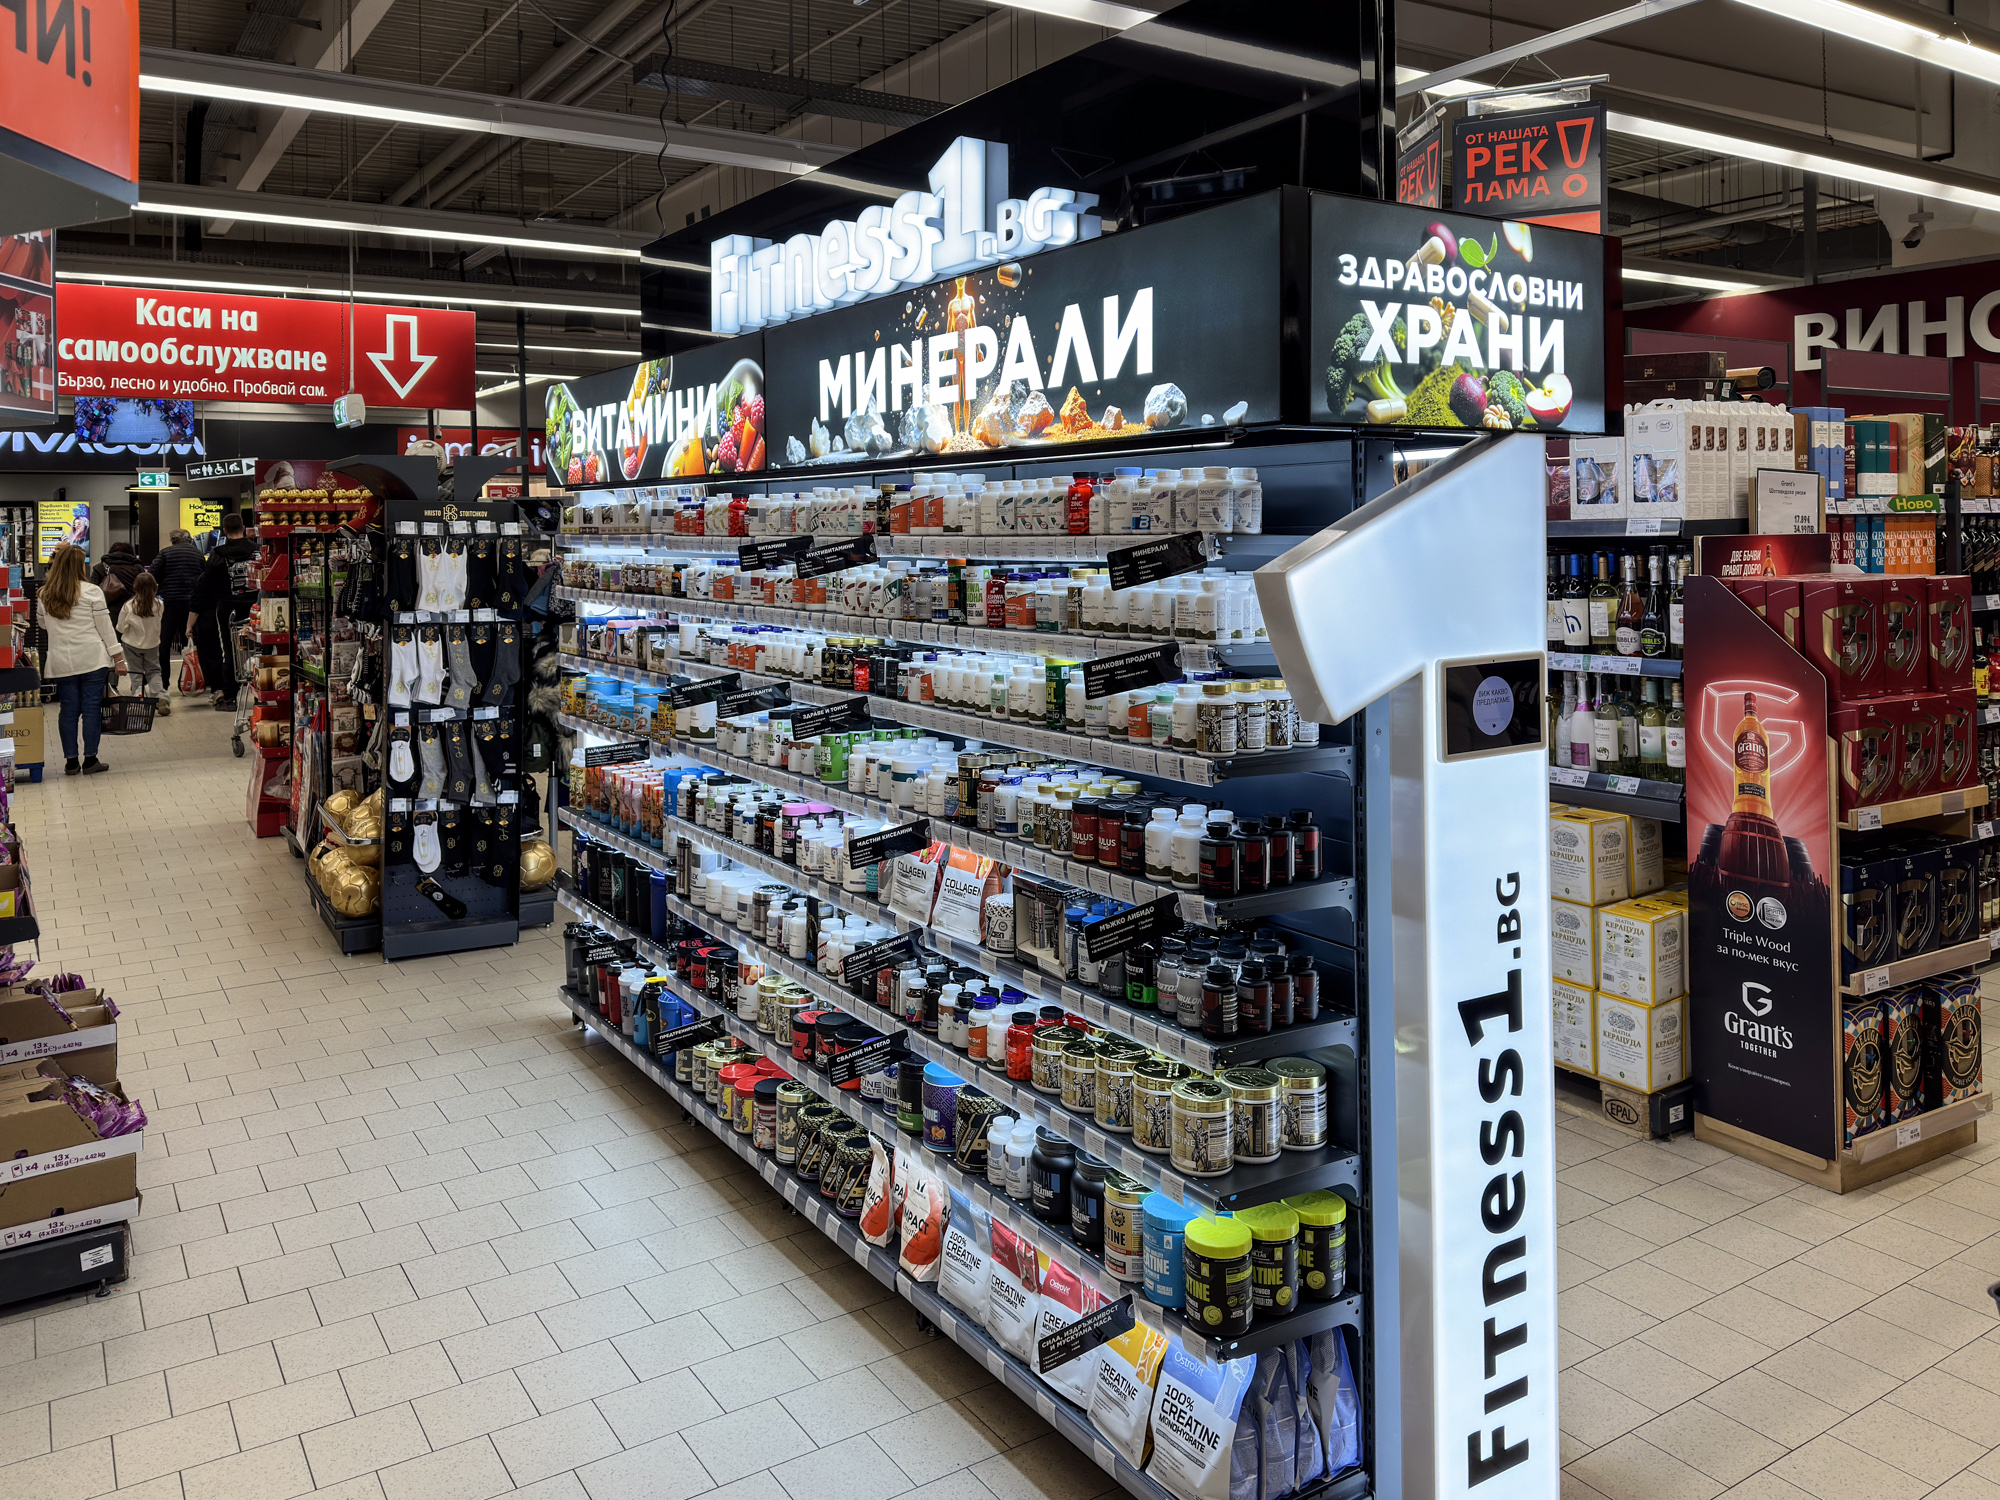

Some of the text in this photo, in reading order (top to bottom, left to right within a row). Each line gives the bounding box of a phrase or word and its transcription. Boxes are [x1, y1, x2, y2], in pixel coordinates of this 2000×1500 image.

[1465, 125, 1549, 145] ОТ НАШАТА
[1466, 139, 1549, 179] РЕК
[1400, 164, 1425, 203] РЕК
[1464, 175, 1551, 204] ЛАМА
[1337, 254, 1583, 311] ЗДРАВОСЛОВНИ
[136, 297, 258, 331] Каси на
[1359, 299, 1565, 375] ХРАНИ
[58, 337, 327, 373] самообслужване
[818, 286, 1154, 422] МИНЕРАЛИ
[58, 372, 327, 397] Бързо, лесно и удобно. Пробвай сам.
[571, 382, 720, 456] ВИТАМИНИ
[1794, 515, 1810, 523] 17.89€
[1132, 543, 1169, 558] МИНЕРАЛИ
[1872, 549, 1882, 557] RAN
[1876, 540, 1885, 549] MO
[1730, 550, 1761, 563] ДВЕ БЪЧВИ
[1721, 564, 1761, 577] ПРАВЯТ ДОБРО
[1091, 650, 1161, 672] БИЛКОВИ ПРОДУКТИ
[1476, 696, 1511, 706] ПРЕДЛАГАМЕ
[1478, 690, 1490, 698] ВИЖ
[802, 709, 824, 720] ЗДРАВЕ
[831, 703, 848, 713] ТОНУС
[1738, 742, 1765, 757] Grant's
[856, 826, 913, 848] МАСТНИ КИСЕЛИНИ
[897, 860, 927, 880] COLLAGEN
[944, 877, 982, 897] COLLAGEN
[1099, 906, 1155, 932] МЪЖКО ЛИБИДО
[1766, 907, 1785, 916] SPIRITS
[1551, 930, 1587, 946] КЕРАЦУДА
[1605, 920, 1645, 936] КЕРАЦУДА
[848, 951, 868, 963] СТАВИ
[873, 935, 909, 953] СУХОЖИЛИЯ
[1722, 927, 1791, 953] Triple Wood
[1716, 944, 1799, 972] за по-мек вкус
[1951, 1005, 1976, 1026] BELUGA
[1603, 1030, 1642, 1048] КЕРАЦУДА
[1724, 1011, 1794, 1050] Grant's
[1854, 1029, 1879, 1051] BELUGA
[5, 1049, 19, 1057] x4
[836, 1049, 864, 1063] СВАЛЯНЕ
[873, 1038, 891, 1049] ТЕГЛО
[1740, 1040, 1777, 1059] TOGETHER
[1610, 1103, 1634, 1122] EPAL
[25, 1162, 39, 1171] x4
[53, 1154, 63, 1162] 13
[18, 1230, 32, 1239] x4
[48, 1221, 58, 1229] 13
[950, 1231, 967, 1247] 100%
[945, 1249, 973, 1272] MONOHYDRATE
[946, 1240, 982, 1270] CREATINE
[991, 1274, 1027, 1308] CREATINE
[1049, 1278, 1071, 1296] OstroVit
[1041, 1335, 1064, 1349] СИЛА,
[1063, 1304, 1119, 1336] ИЗДРЪЖЛИВОСТ
[1056, 1326, 1093, 1348] МУСКУЛНА
[1093, 1315, 1112, 1330] МАСА
[1174, 1351, 1205, 1378] OstroVit
[1165, 1384, 1194, 1412] 100%
[1158, 1413, 1206, 1454] MONOHYDRATE
[1161, 1398, 1221, 1451] CREATINE
